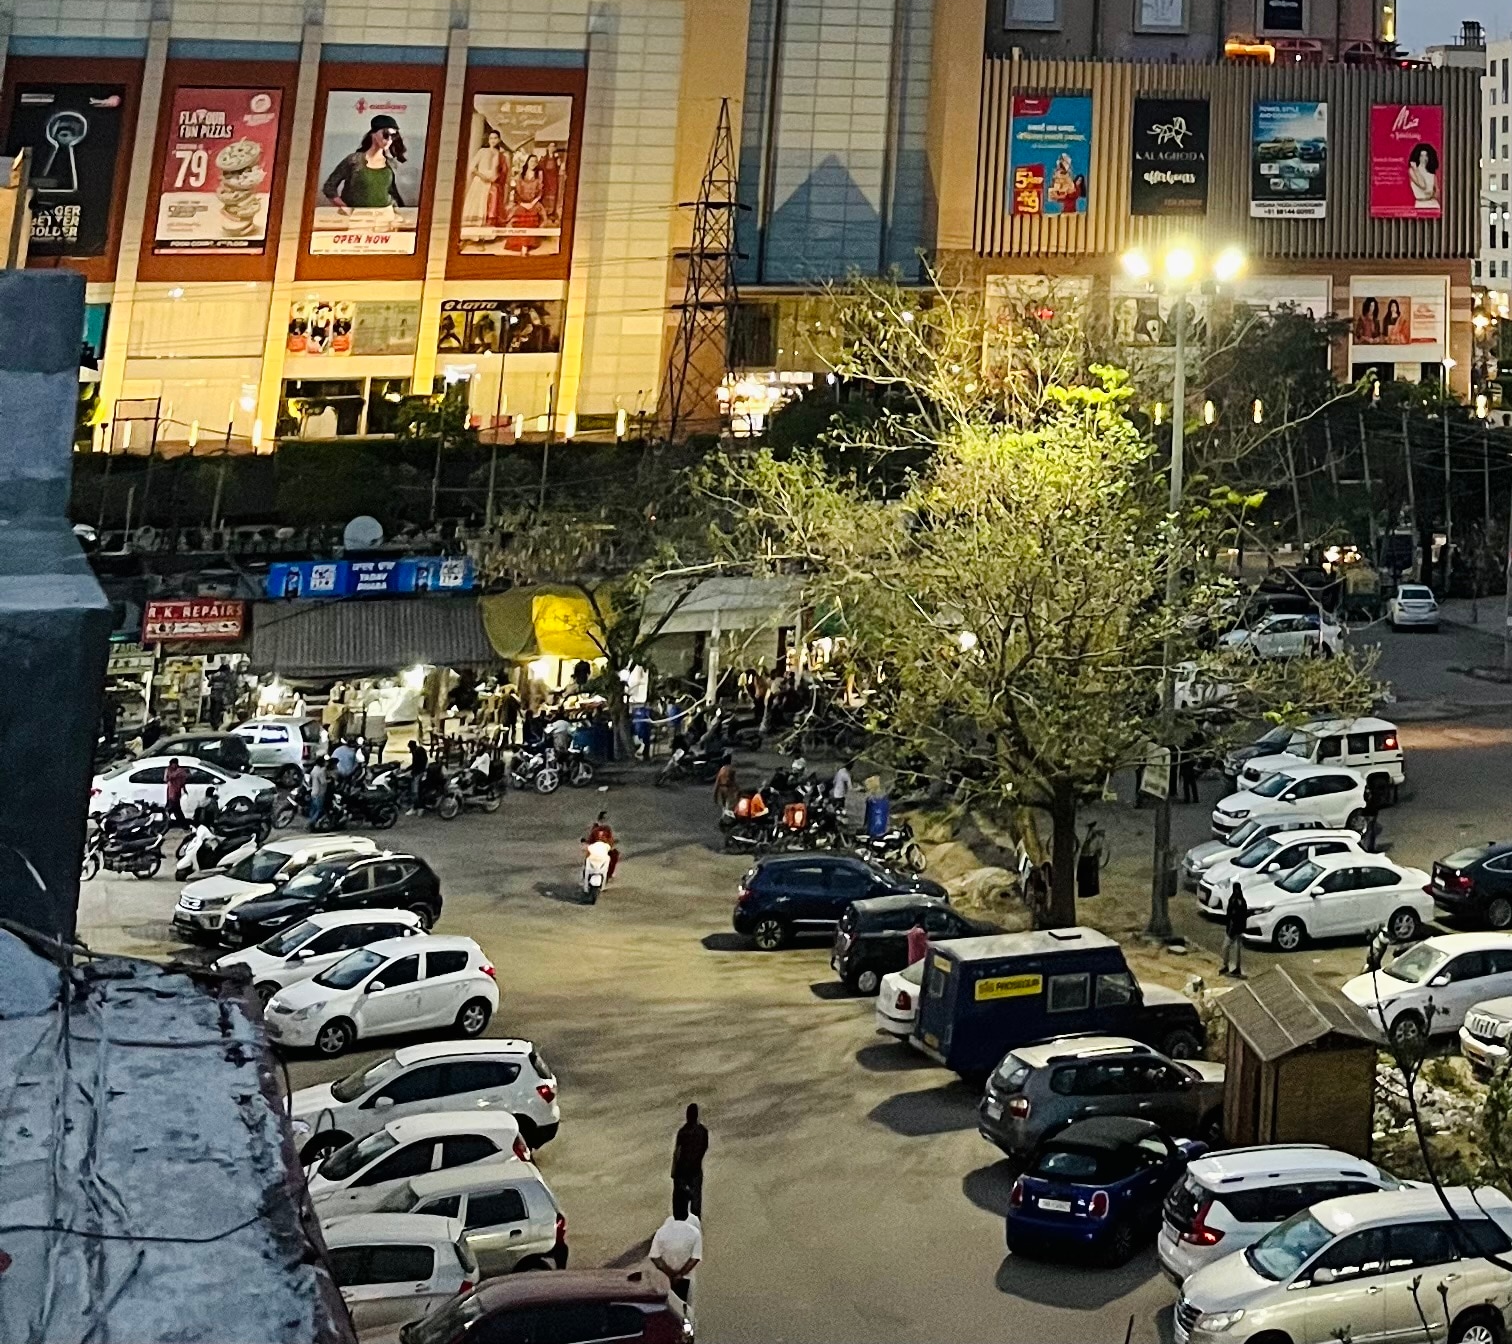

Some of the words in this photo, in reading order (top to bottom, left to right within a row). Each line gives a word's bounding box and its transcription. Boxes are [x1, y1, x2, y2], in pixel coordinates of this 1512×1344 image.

[174, 150, 209, 188] 79
[333, 234, 362, 244] OPEN
[365, 234, 391, 244] NOW
[183, 604, 242, 618] REPAIRS
